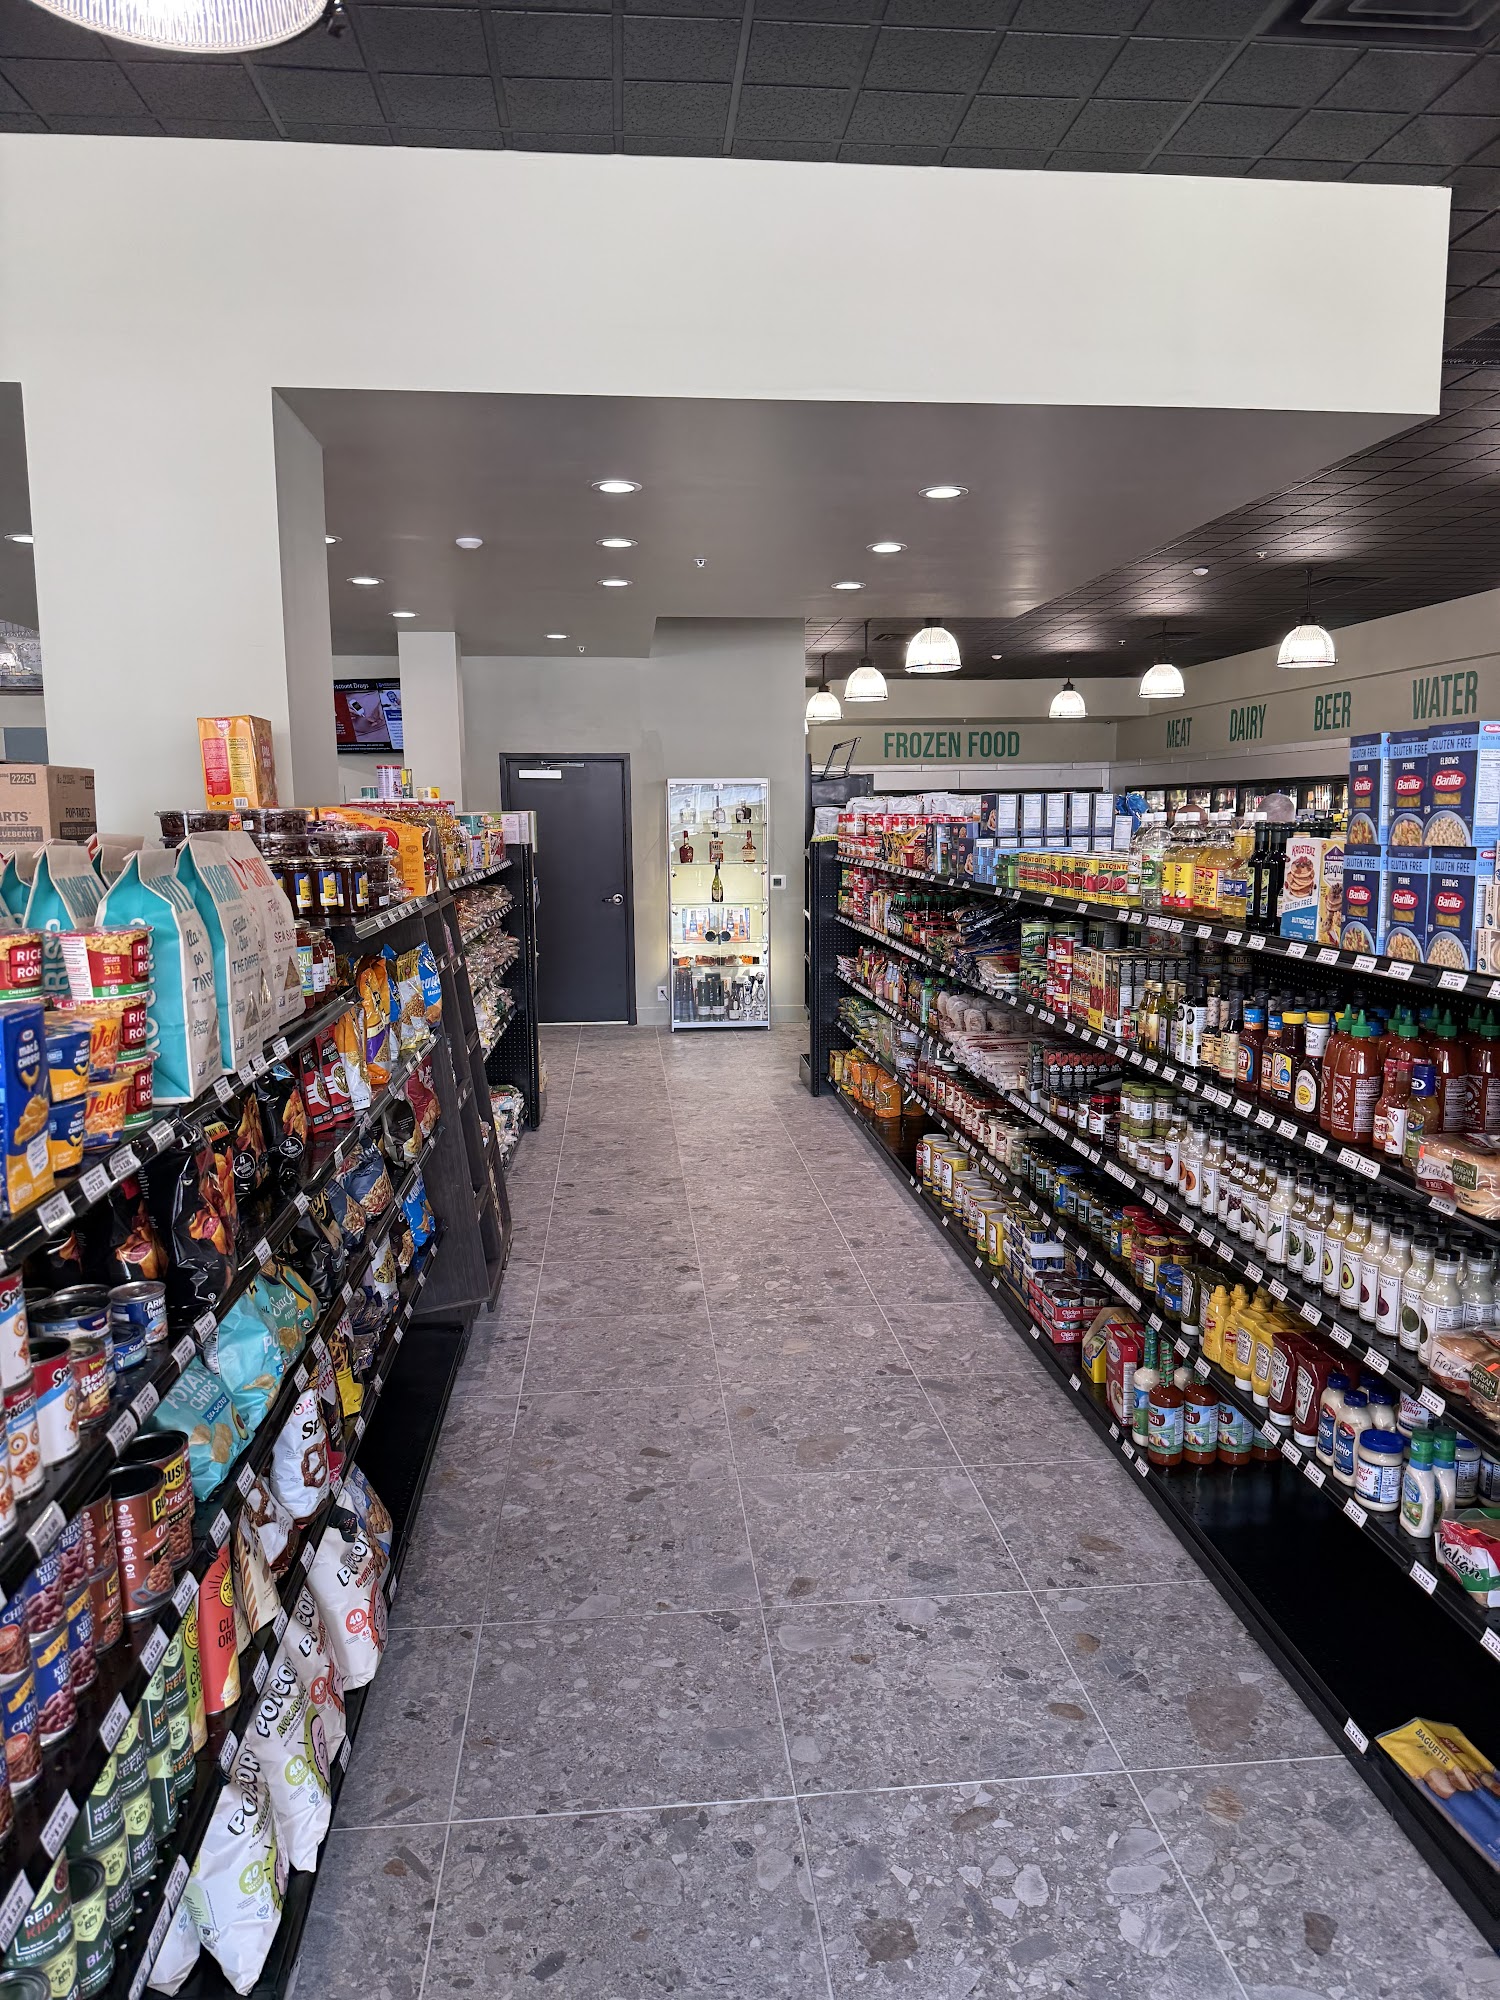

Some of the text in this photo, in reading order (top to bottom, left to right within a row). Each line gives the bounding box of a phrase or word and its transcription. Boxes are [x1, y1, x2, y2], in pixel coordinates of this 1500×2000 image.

[1412, 671, 1478, 720] WATER
[1313, 691, 1351, 731] BEER
[1229, 704, 1267, 742] DAIRY
[1166, 717, 1193, 748] MEAT
[884, 731, 1020, 758] FROZEN FOOD
[1393, 744, 1428, 756] GLUTEN FREE
[1432, 737, 1472, 750] GLUTEN FREE
[1352, 747, 1377, 758] GLUTEN FREE
[1402, 762, 1415, 770] PENNE
[1440, 756, 1459, 765] ELBOWS
[11, 773, 35, 784] 22254
[1397, 778, 1421, 790] Barilla
[1435, 775, 1463, 786] Barilla
[1354, 780, 1371, 791] Barilla
[1347, 858, 1375, 868] GLUTEN FREE
[1391, 860, 1422, 871] GLUTEN FREE
[1435, 861, 1470, 872] GLUTEN FREE
[1398, 877, 1410, 885] PENNE
[1442, 879, 1458, 888] ELBOWS
[1348, 889, 1369, 901] Barilla
[1393, 894, 1416, 905] Barilla
[1284, 897, 1312, 910] GLUTEN FREE
[1437, 896, 1461, 909] Barilla
[17, 948, 41, 961] RICE
[104, 966, 111, 975] 3
[1453, 1164, 1474, 1177] ARTISAN
[1061, 1309, 1080, 1317] Chicken
[1061, 1331, 1080, 1339] Chicken
[1470, 1369, 1496, 1389] ARTISAN
[190, 1380, 219, 1411] CHIPS
[207, 1408, 217, 1420] SEA
[1439, 1533, 1483, 1581] Italian
[1462, 1554, 1479, 1568] STYLE
[350, 1611, 362, 1625] 40
[192, 1687, 197, 1699] &
[314, 1681, 325, 1696] 40
[1415, 1728, 1449, 1765] BAGUETTE
[289, 1758, 304, 1776] 40
[130, 1802, 149, 1822] CADIA
[244, 1864, 260, 1884] 40
[24, 1902, 52, 1928] RED
[77, 1905, 101, 1927] CADIA
